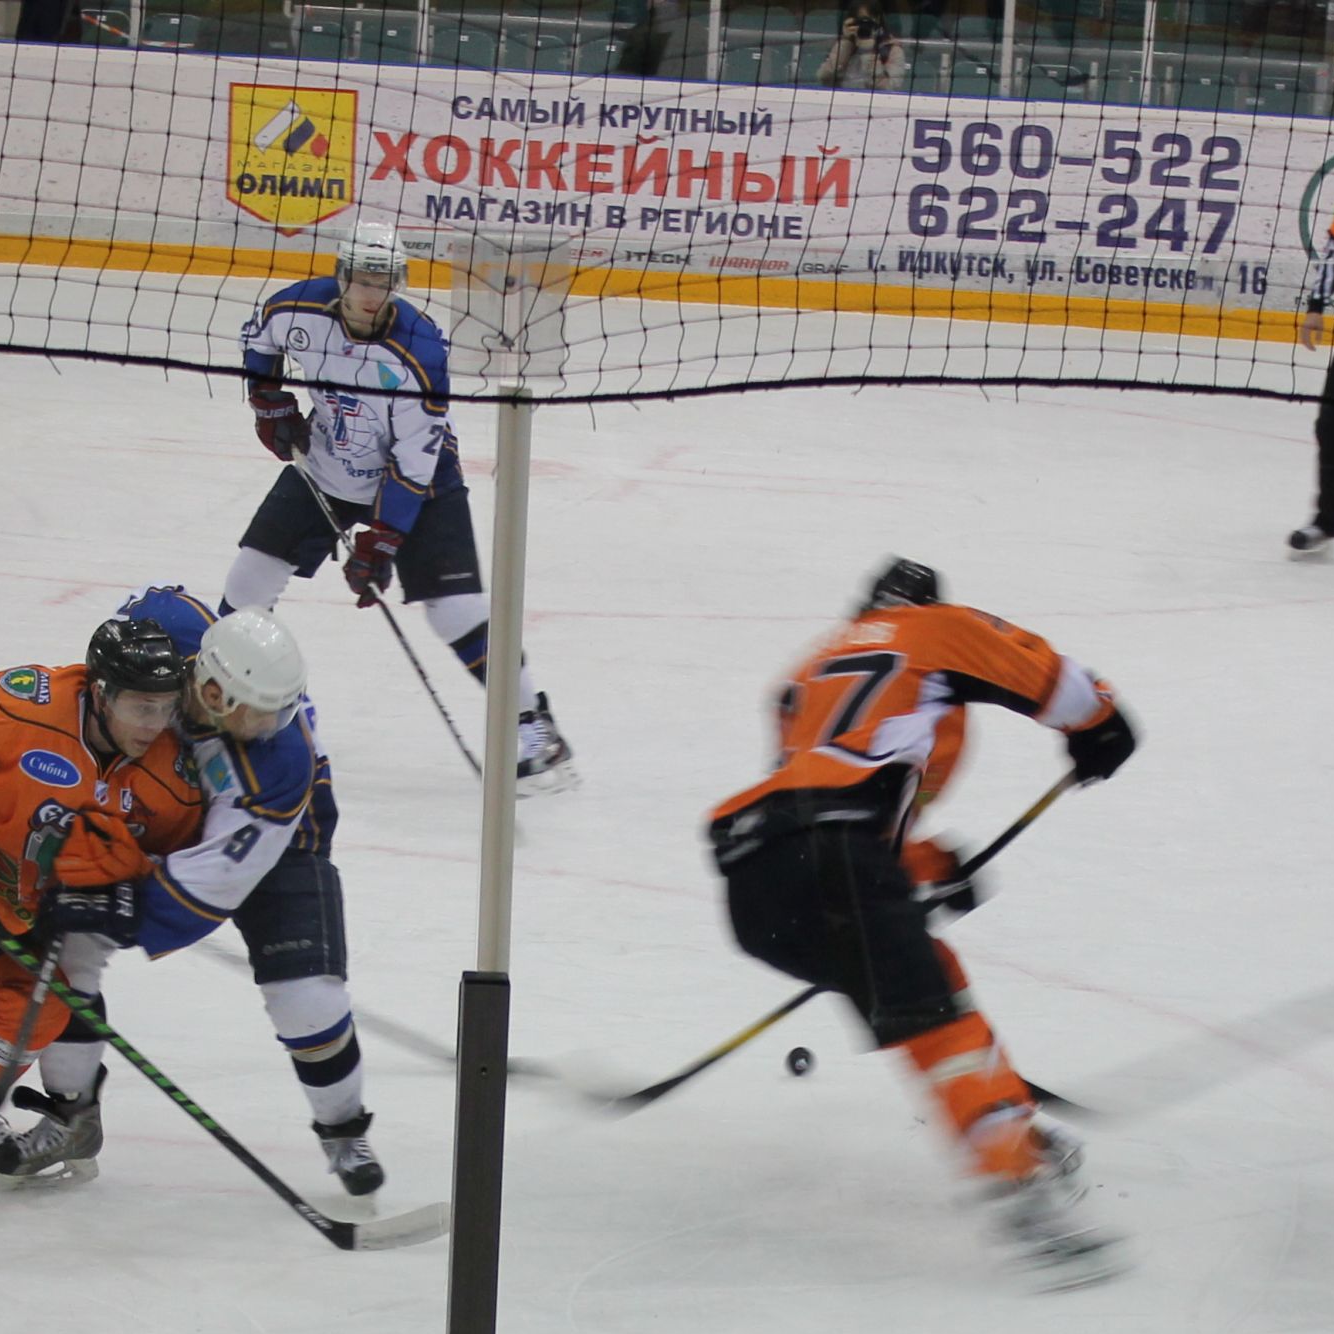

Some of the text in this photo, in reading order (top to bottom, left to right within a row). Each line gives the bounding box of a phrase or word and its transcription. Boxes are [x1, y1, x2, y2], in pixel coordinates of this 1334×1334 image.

[451, 95, 774, 137] САМЫЙ КРУПНЫЙ
[369, 131, 850, 208] ХОККЕЙНЫЙ
[910, 119, 1242, 192] 560-522
[236, 173, 345, 199] ОЛИМП
[425, 194, 803, 240] МАГАЗИН В РЕГИОНЕ
[907, 183, 1237, 255] 622-247
[1238, 261, 1269, 296] 16
